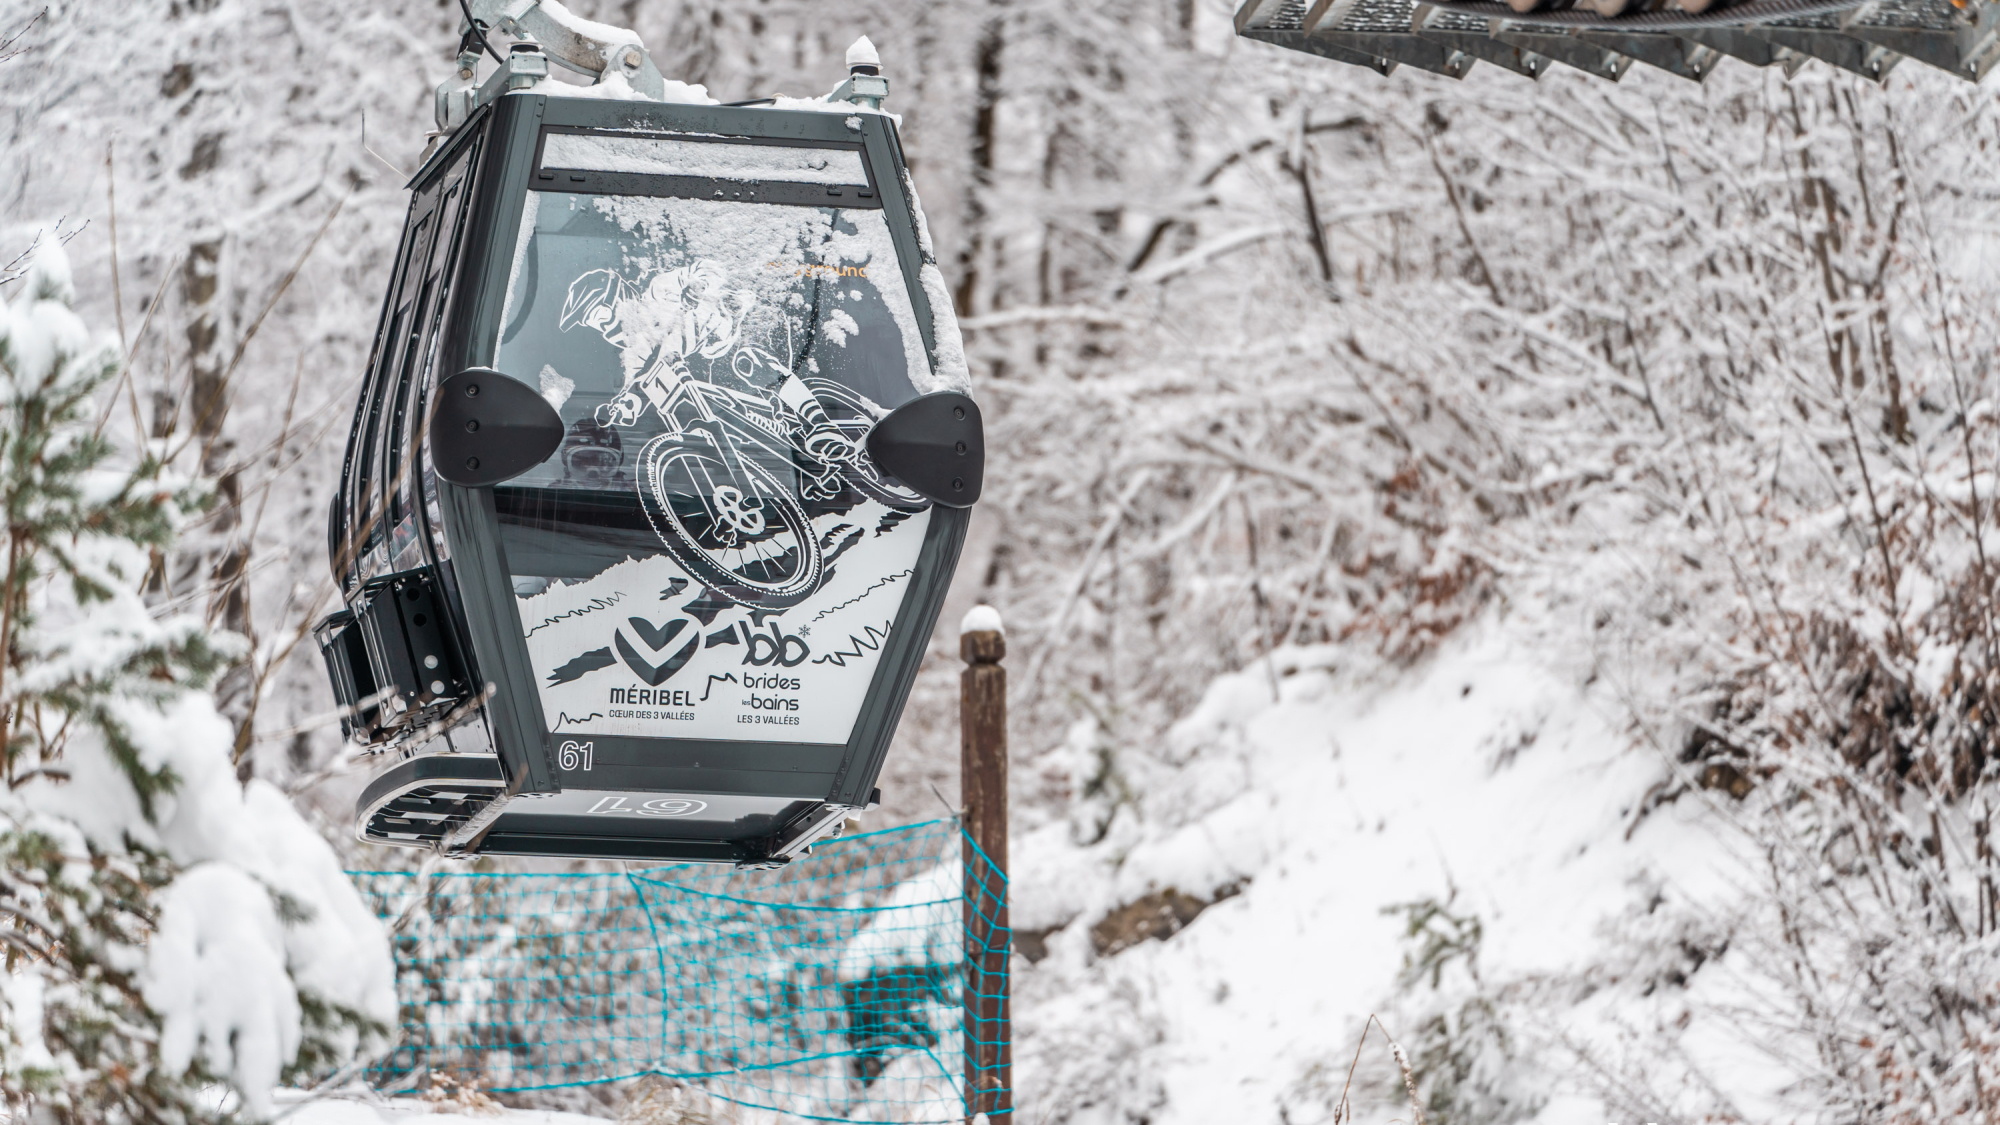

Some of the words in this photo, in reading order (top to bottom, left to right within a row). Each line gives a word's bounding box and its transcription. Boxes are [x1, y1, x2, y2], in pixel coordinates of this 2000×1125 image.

[743, 671, 801, 690] brides
[609, 683, 696, 707] MÉRIBEL
[751, 692, 799, 711] bains
[608, 709, 634, 719] CŒUR
[635, 710, 652, 719] DES
[653, 711, 659, 720] 3
[660, 710, 695, 721] VALLÉES
[737, 714, 753, 724] LES
[754, 715, 761, 724] 3
[762, 714, 800, 726] VALLÉES
[558, 740, 594, 771] 61
